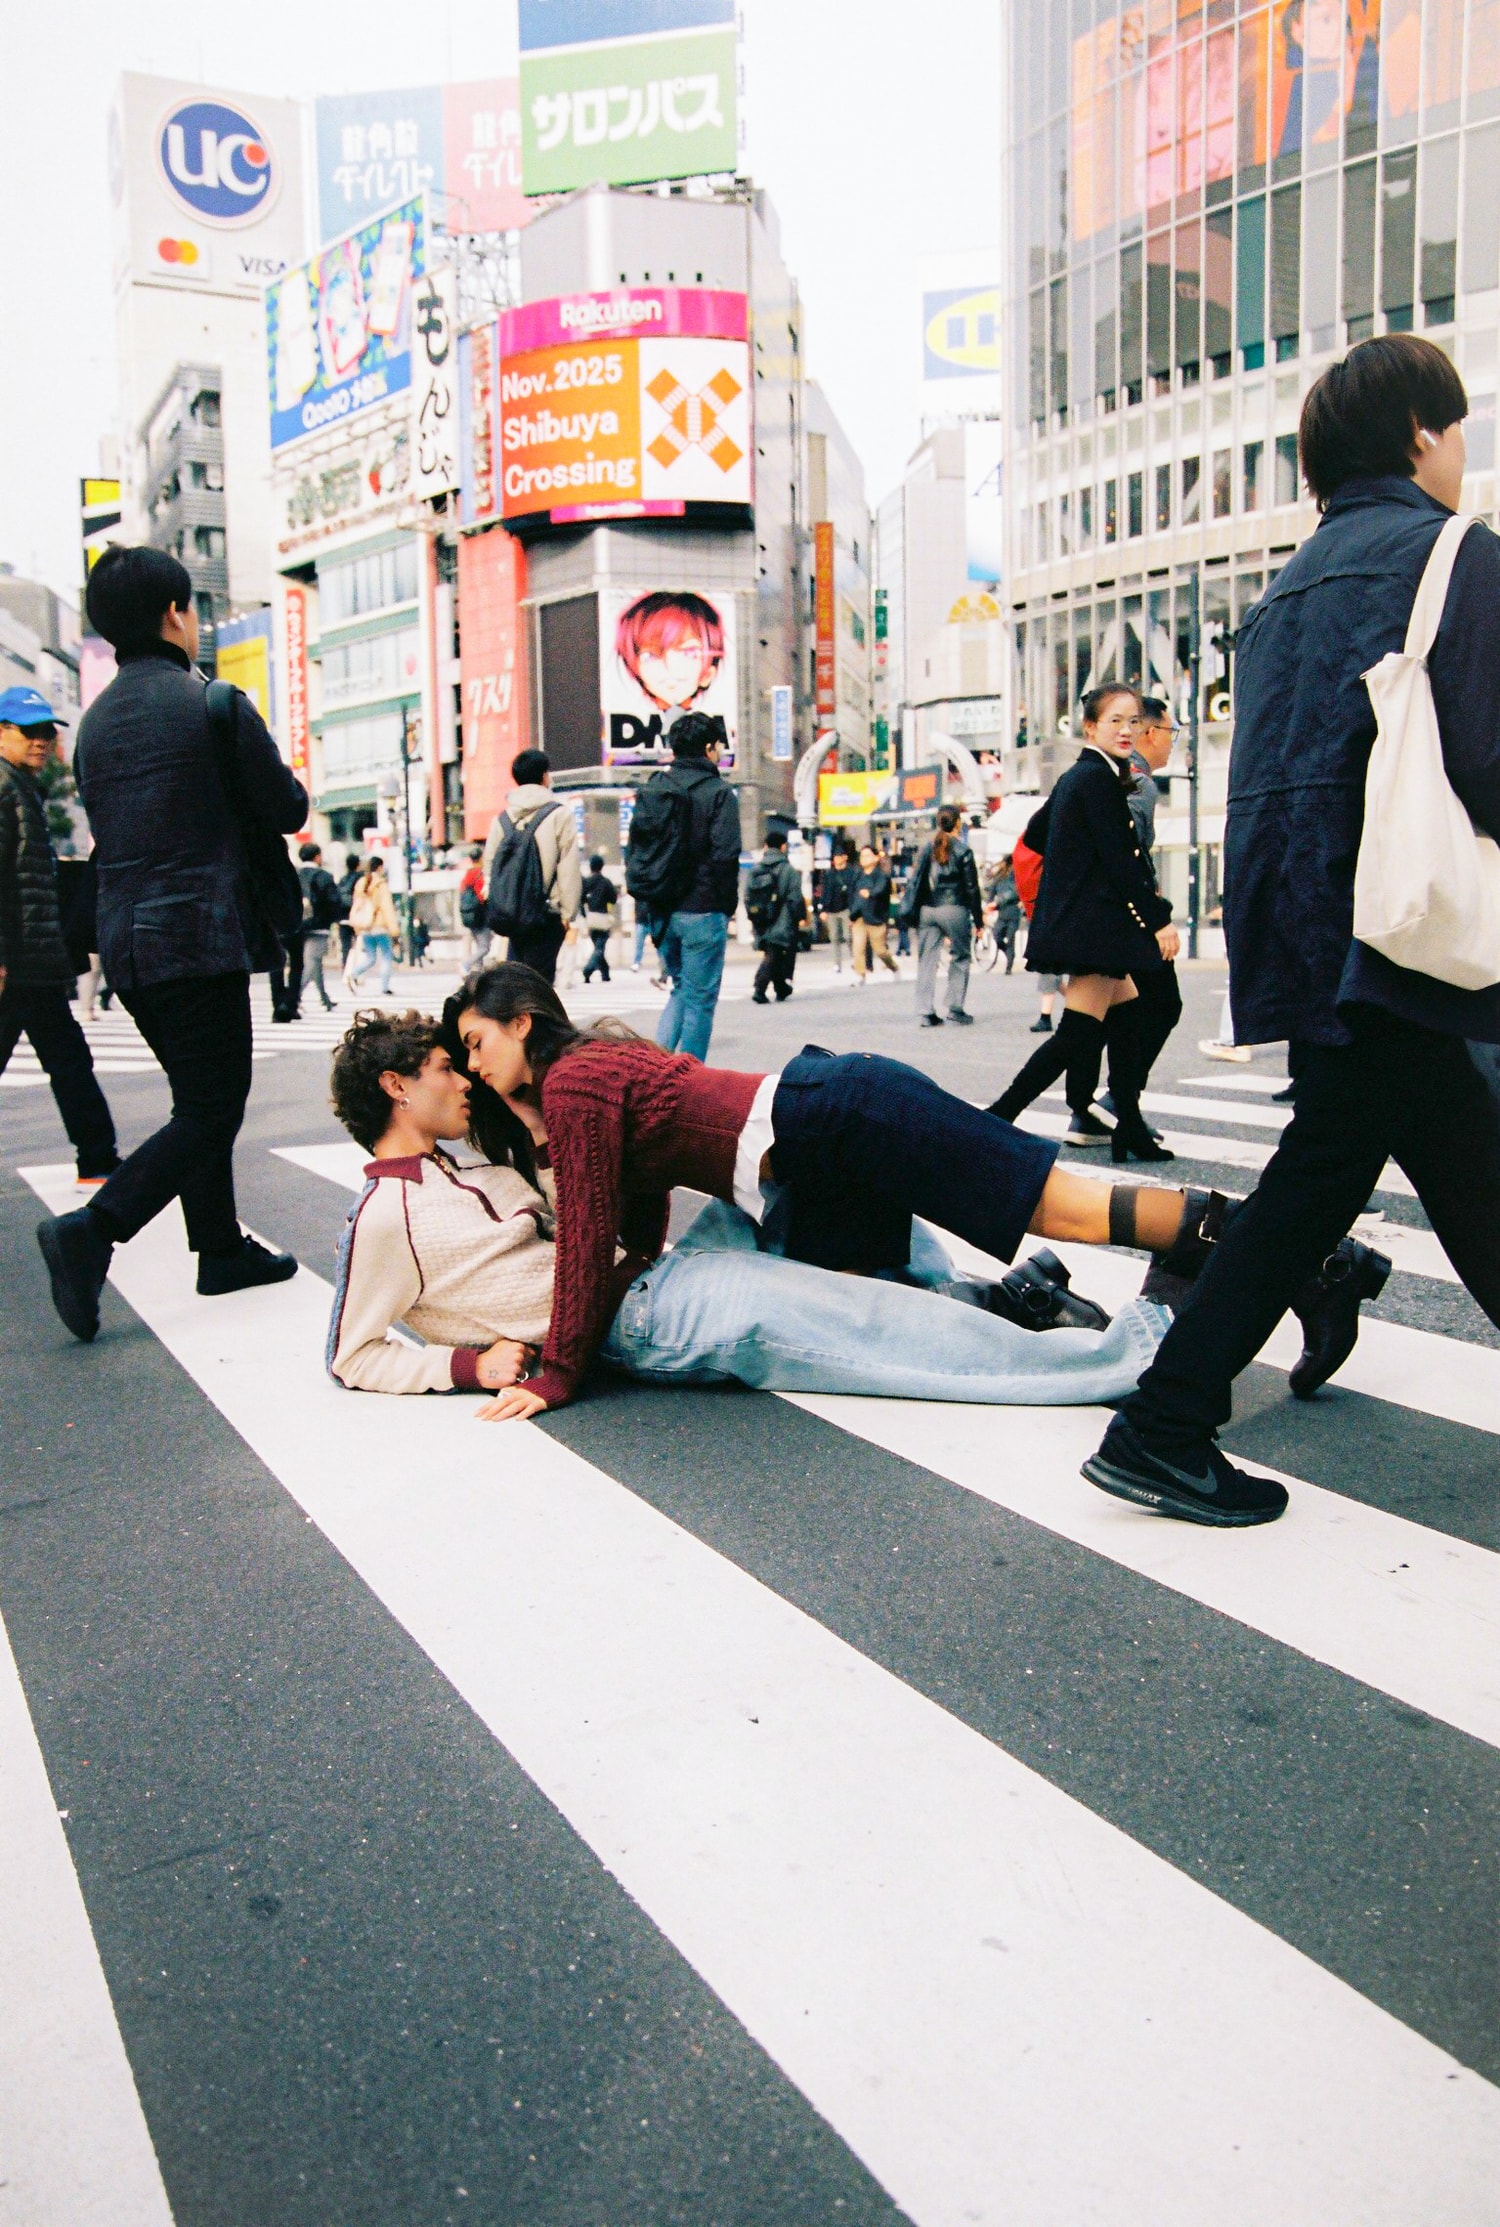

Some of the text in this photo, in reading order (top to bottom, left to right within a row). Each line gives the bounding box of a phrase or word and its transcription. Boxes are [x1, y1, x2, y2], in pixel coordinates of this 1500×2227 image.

[531, 73, 724, 151] サロンパス
[240, 255, 287, 275] VISA
[560, 298, 662, 331] Rakuten
[417, 278, 452, 484] もんじゃ
[502, 354, 623, 403] Nov.2025
[504, 410, 619, 451] Shibuya
[505, 452, 636, 497] Crossing
